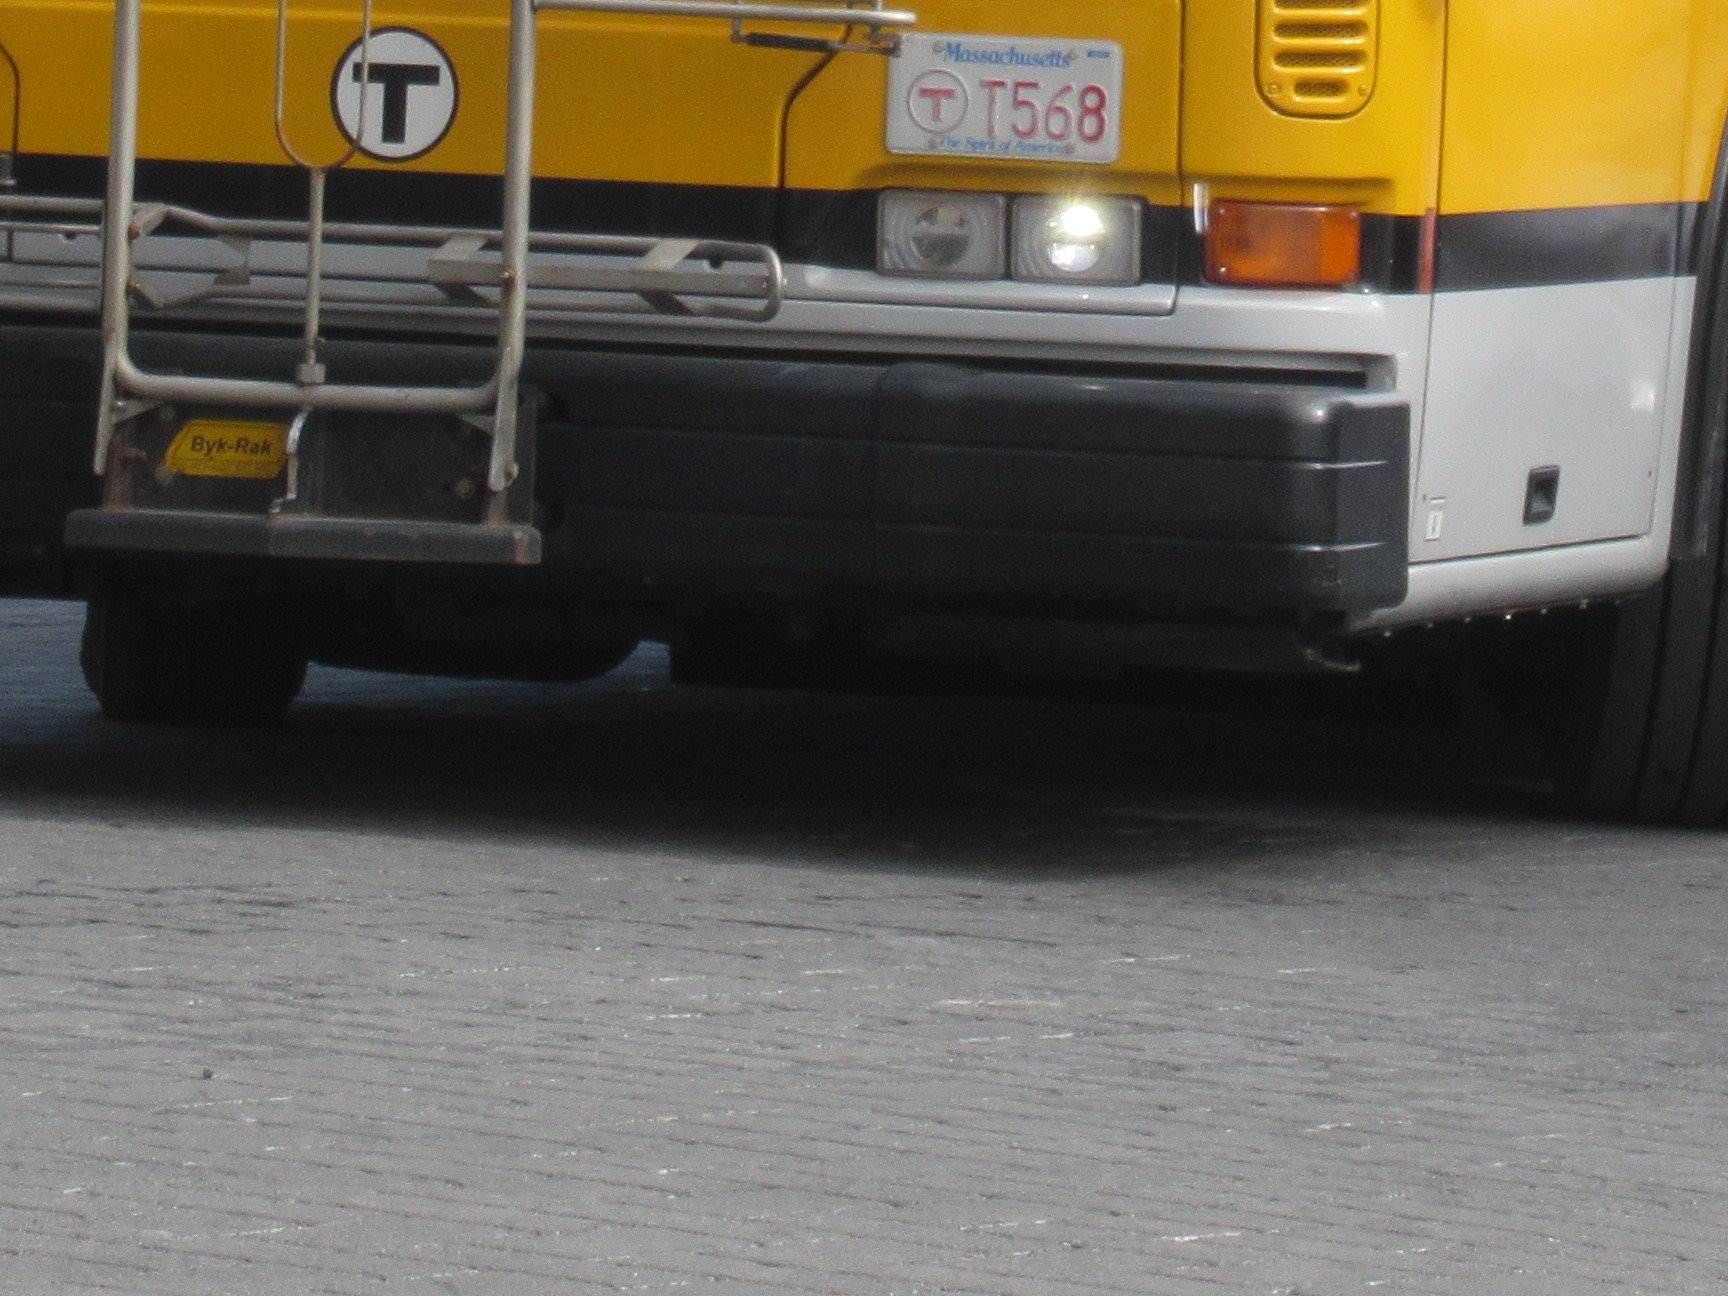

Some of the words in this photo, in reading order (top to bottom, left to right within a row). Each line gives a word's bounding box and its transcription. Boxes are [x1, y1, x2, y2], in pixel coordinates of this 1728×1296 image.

[944, 42, 1071, 69] Massachusetts
[352, 62, 441, 144] T
[980, 79, 1108, 143] T568
[190, 435, 271, 456] Byk-Rak
